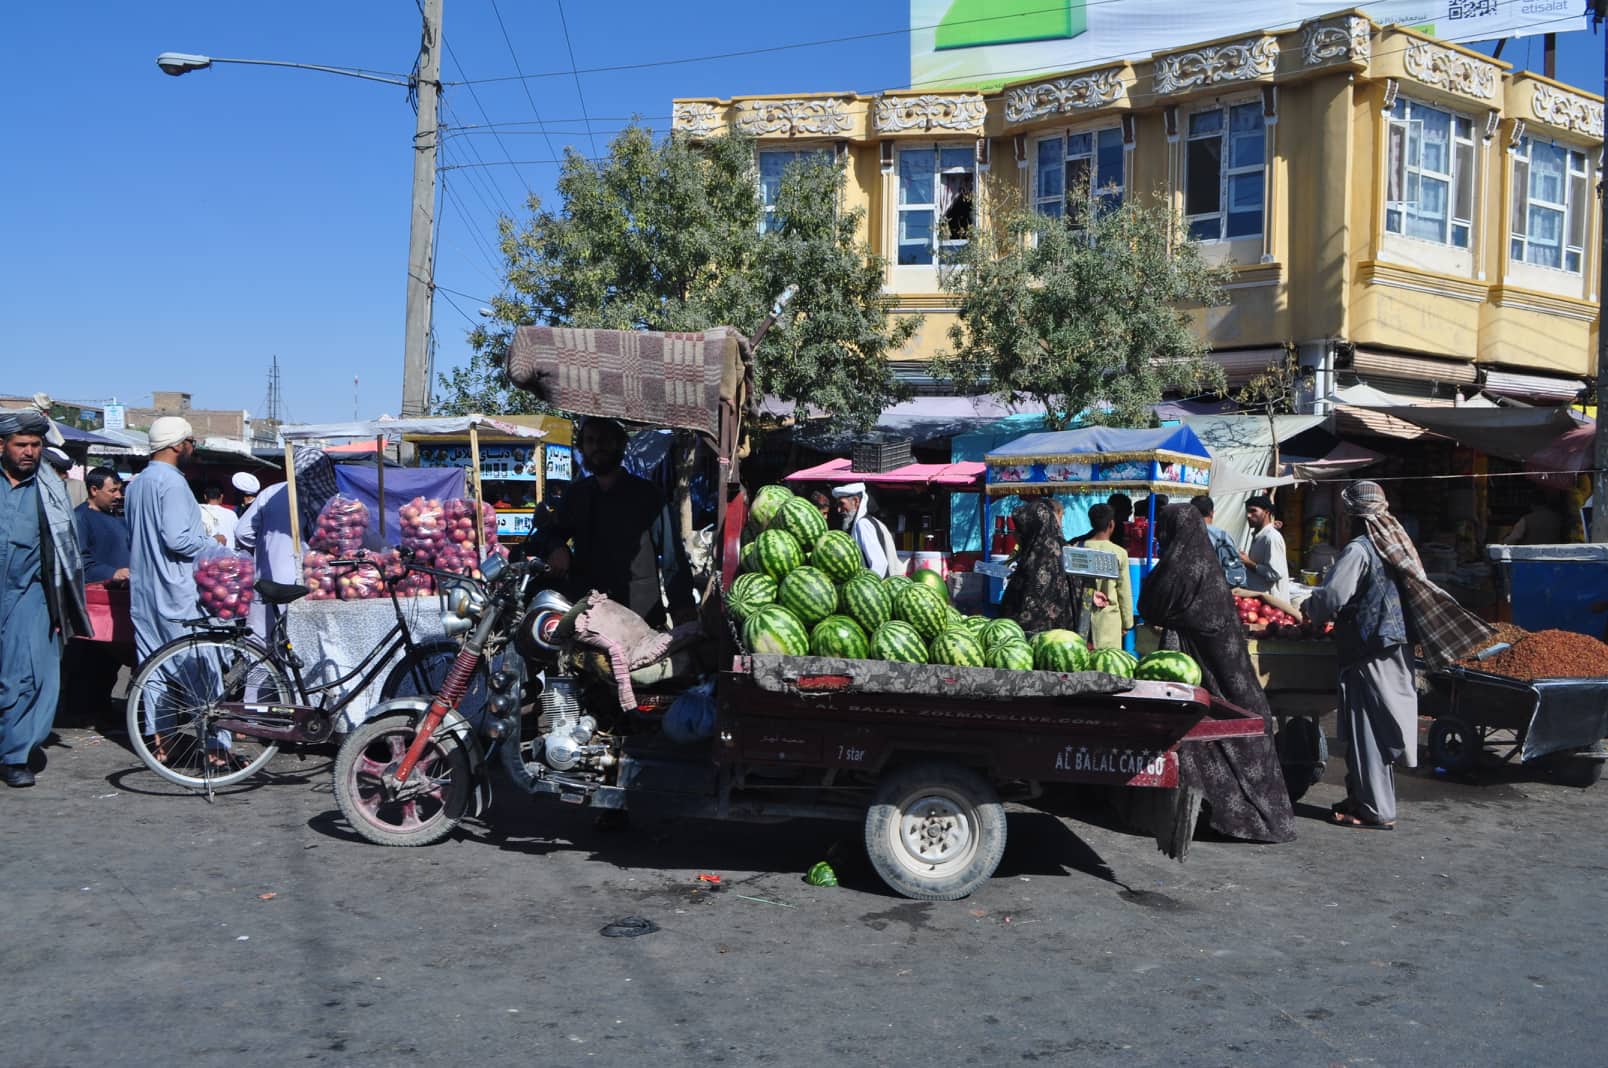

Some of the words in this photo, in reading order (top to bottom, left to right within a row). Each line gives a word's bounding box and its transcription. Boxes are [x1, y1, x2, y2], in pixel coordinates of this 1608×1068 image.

[1521, 0, 1568, 14] etisalat
[838, 745, 844, 760] 7
[846, 748, 865, 761] star
[1055, 752, 1071, 770] AL
[1074, 752, 1116, 773] BALAL
